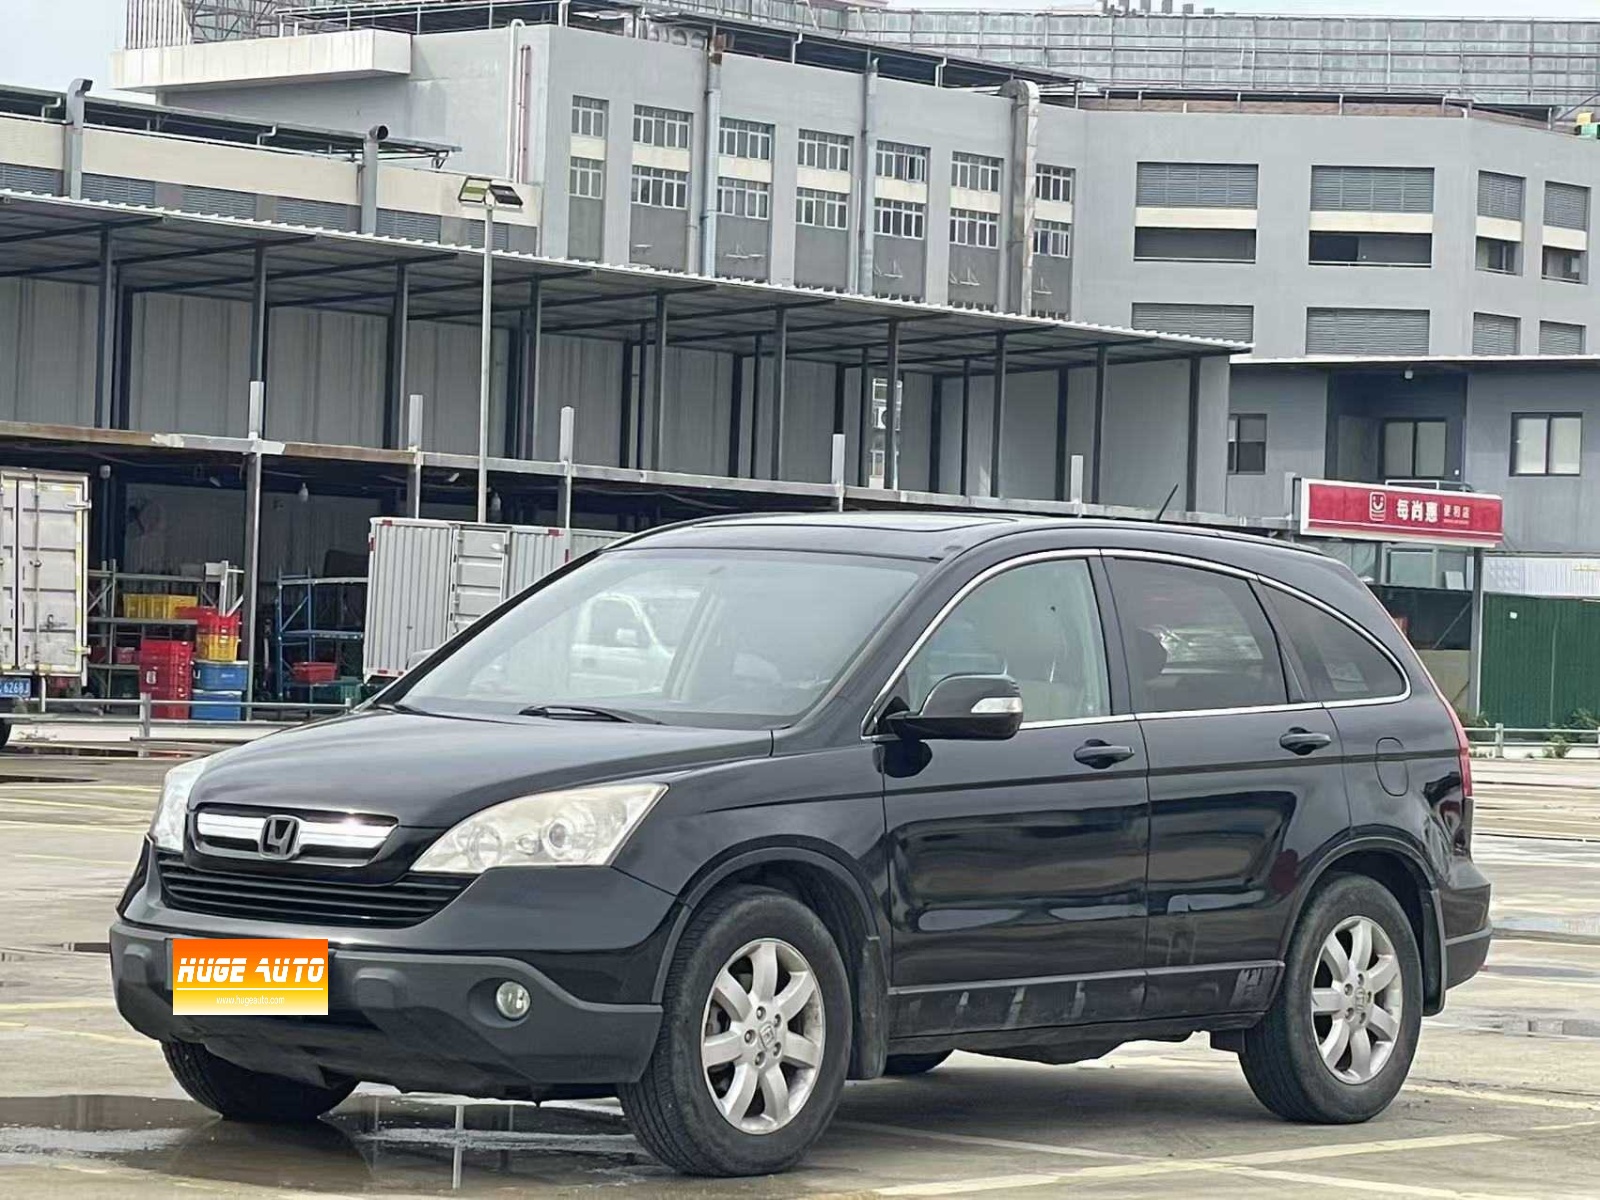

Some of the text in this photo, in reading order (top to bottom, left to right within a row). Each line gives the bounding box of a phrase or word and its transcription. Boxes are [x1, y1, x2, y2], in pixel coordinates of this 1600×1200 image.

[1396, 499, 1438, 523] 每尚惠
[0, 681, 30, 694] 6268J
